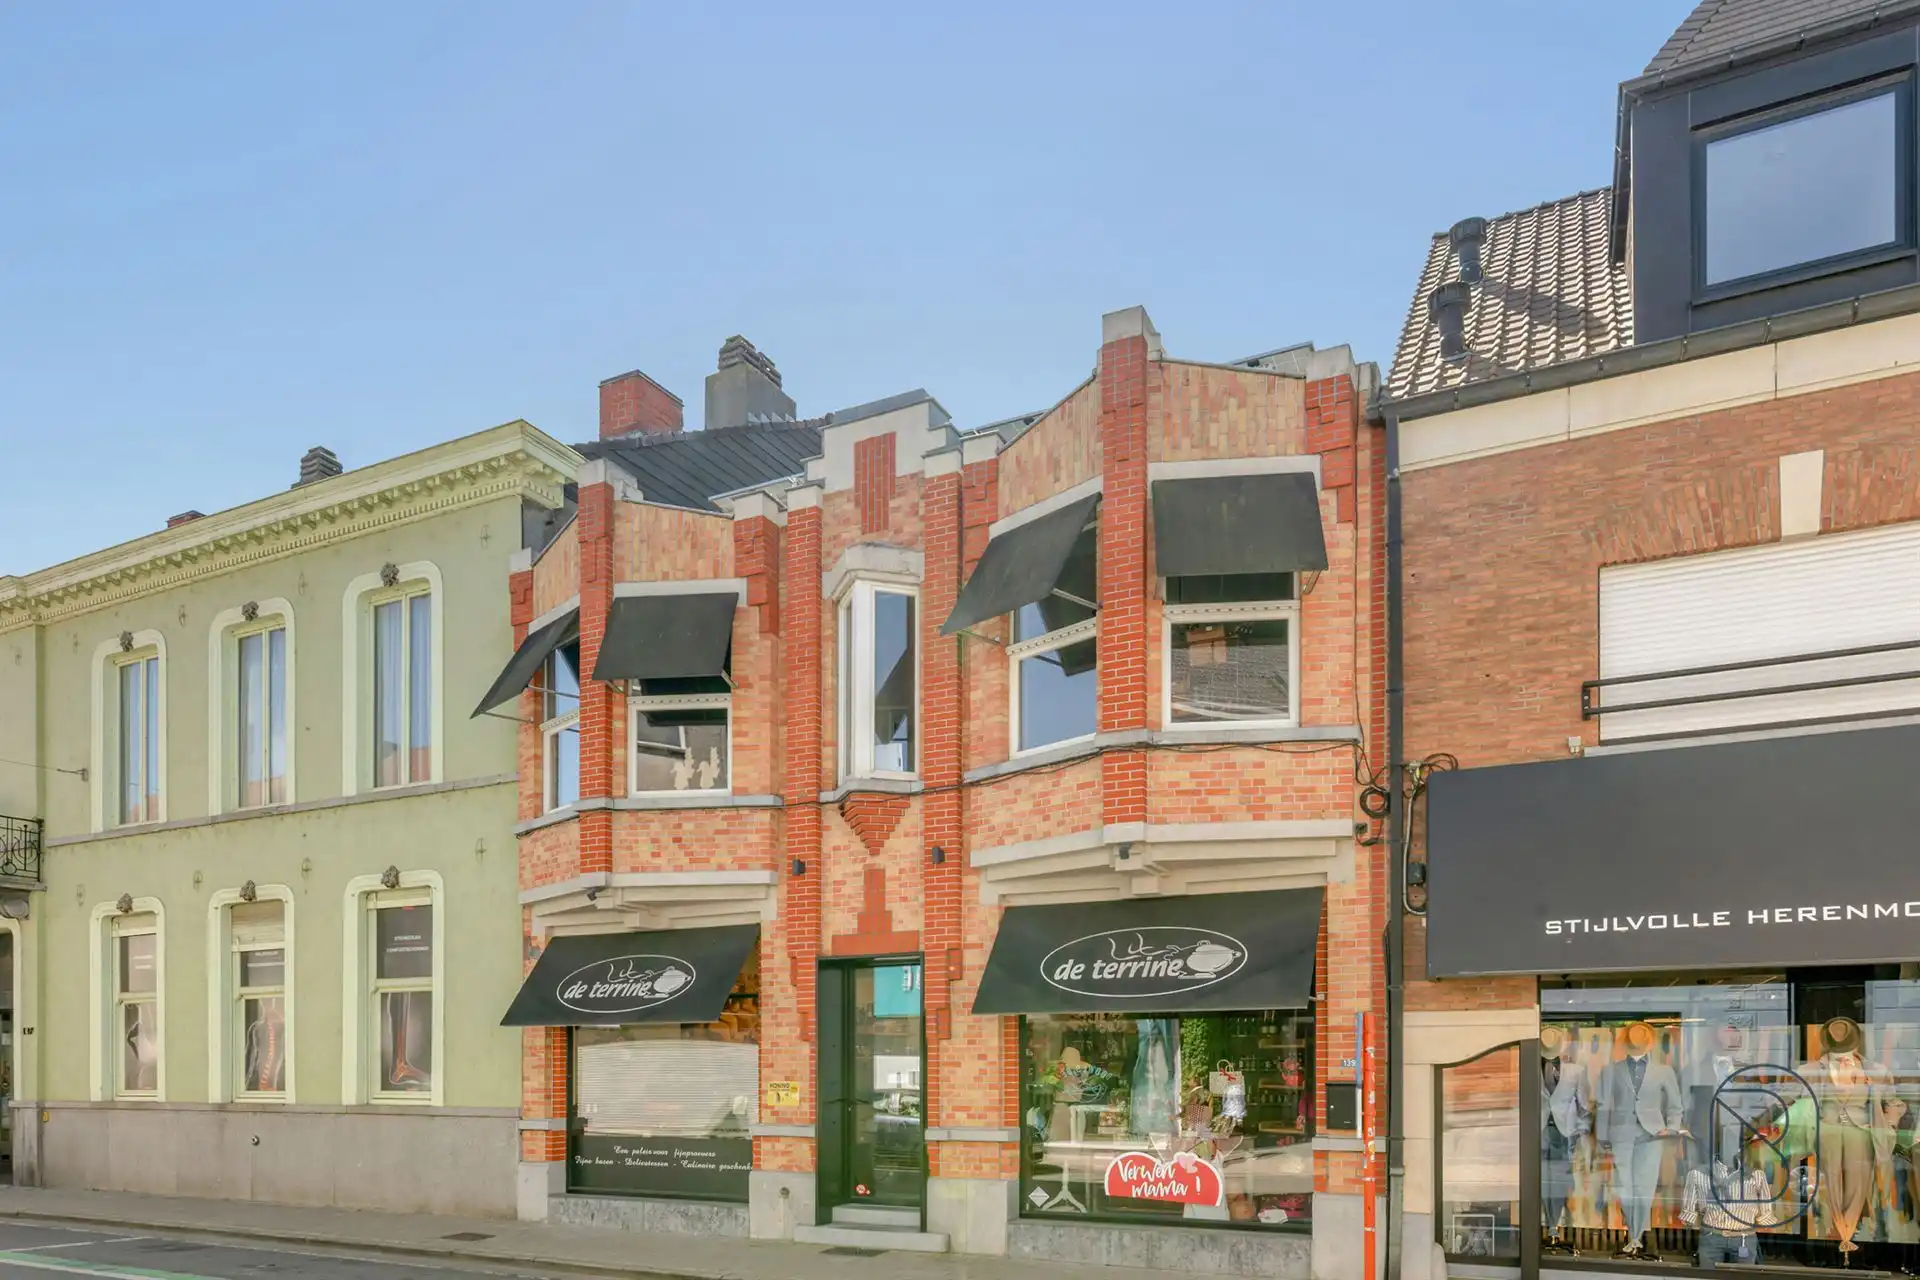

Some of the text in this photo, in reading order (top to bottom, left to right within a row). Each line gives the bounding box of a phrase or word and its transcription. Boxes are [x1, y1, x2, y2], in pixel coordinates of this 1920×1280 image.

[1545, 911, 1731, 935] STIJLVOLLE
[1053, 956, 1185, 981] de terrine
[563, 979, 653, 999] de terrine
[613, 1145, 629, 1154] Een
[574, 1155, 593, 1166] Fijne
[625, 1157, 669, 1167] Delicatessen
[681, 1159, 716, 1169] Culinaire
[719, 1162, 753, 1172] geschenk
[1117, 1158, 1176, 1183] Verwen
[1131, 1180, 1189, 1198] mama
